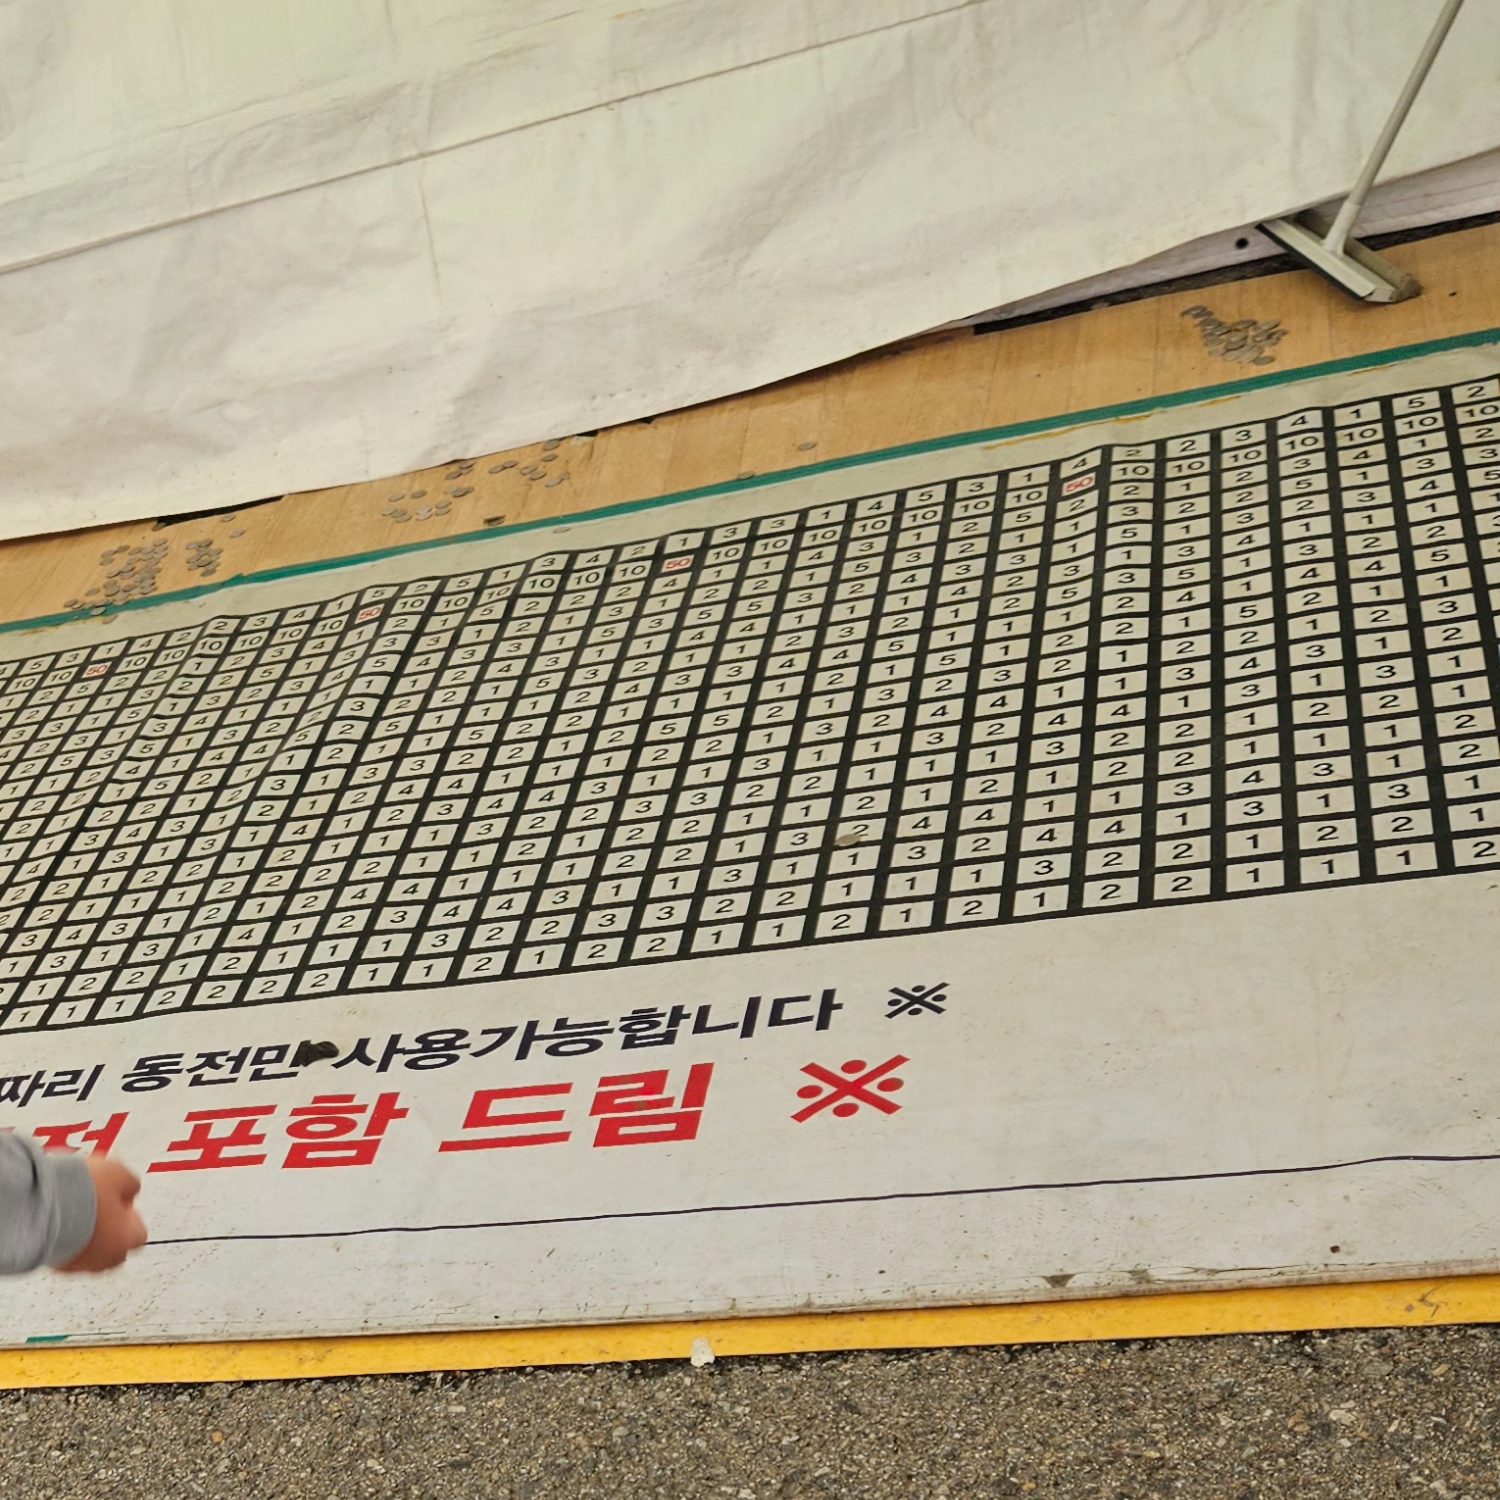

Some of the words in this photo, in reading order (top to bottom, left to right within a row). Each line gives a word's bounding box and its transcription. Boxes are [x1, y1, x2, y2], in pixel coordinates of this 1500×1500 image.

[488, 587, 511, 599] 10
[531, 578, 555, 589] 10
[576, 572, 600, 585] 10
[620, 565, 646, 577] 10
[666, 558, 691, 569] 50
[714, 548, 740, 560] 10
[761, 539, 788, 551] 10
[810, 530, 837, 542] 10
[859, 520, 887, 532] 10
[909, 510, 938, 522] 10
[961, 501, 990, 512] 10
[1013, 491, 1043, 503] 10
[1066, 477, 1093, 492] 50
[1120, 465, 1149, 476] 10
[1173, 461, 1205, 473] 10
[1230, 450, 1262, 462] 10
[1286, 436, 1319, 450] 10
[1343, 428, 1377, 441] 10
[1404, 416, 1438, 429] 10
[1464, 405, 1499, 417] 10
[503, 570, 510, 579] 1
[541, 558, 556, 567] 3
[586, 554, 600, 563] 4
[631, 546, 646, 556] 2
[680, 537, 688, 547] 1
[723, 527, 738, 538] 3
[770, 519, 785, 528] 3
[822, 510, 830, 519] 1
[868, 501, 882, 510] 4
[918, 490, 933, 502] 5
[969, 482, 984, 492] 3
[1024, 472, 1032, 482] 1
[1072, 458, 1087, 469] 4
[1180, 440, 1196, 452] 2
[1236, 429, 1252, 442] 3
[1291, 415, 1308, 426] 4
[1350, 409, 1361, 419] 1
[1408, 397, 1425, 408] 5
[1468, 386, 1485, 398] 2
[888, 640, 904, 652] 5
[947, 631, 956, 642] 1
[1003, 621, 1013, 632] 1
[1061, 611, 1071, 622] 1
[1117, 596, 1134, 609] 2
[1176, 591, 1195, 602] 4
[1241, 581, 1251, 591] 1
[1300, 567, 1320, 579] 4
[1364, 560, 1385, 571] 4
[1431, 549, 1450, 562] 5
[5, 847, 13, 857] 1
[46, 840, 54, 850] 1
[84, 834, 99, 846] 3
[126, 827, 141, 838] 4
[170, 821, 186, 832] 3
[219, 814, 227, 825] 1
[257, 805, 275, 816] 2
[309, 799, 317, 810] 1
[350, 792, 368, 804] 2
[398, 784, 414, 795] 4
[447, 778, 463, 789] 4
[502, 773, 511, 784] 1
[552, 765, 561, 776] 1
[604, 756, 612, 767] 1
[651, 748, 669, 761] 2
[705, 739, 722, 753] 2
[764, 732, 773, 744] 1
[816, 722, 833, 735] 3
[872, 714, 890, 727] 2
[930, 705, 949, 717] 4
[990, 695, 1008, 707] 4
[1054, 686, 1064, 698] 1
[1115, 677, 1126, 690] 1
[1176, 667, 1195, 681] 3
[1239, 657, 1260, 669] 4
[1306, 645, 1325, 658] 3
[1375, 637, 1387, 649] 1
[1442, 627, 1463, 641] 2
[20, 1011, 30, 1022] 1
[67, 1005, 77, 1018] 1
[115, 1000, 125, 1012] 1
[157, 991, 176, 1005] 2
[207, 985, 226, 999] 2
[259, 980, 277, 994] 2
[310, 973, 329, 988] 2
[368, 968, 379, 981] 1
[423, 964, 433, 977] 1
[473, 957, 492, 972] 2
[535, 950, 545, 964] 1
[587, 944, 607, 959] 2
[647, 937, 666, 952] 2
[711, 930, 722, 944] 1
[772, 923, 784, 937] 1
[831, 914, 851, 930] 2
[900, 908, 912, 923] 1
[962, 900, 983, 916] 2
[1034, 892, 1045, 907] 1
[1100, 884, 1121, 900] 2
[1171, 876, 1192, 892] 2
[1247, 868, 1259, 883] 1
[1321, 859, 1334, 874] 1
[1397, 850, 1410, 865] 1
[1473, 841, 1496, 858] 2
[21, 934, 38, 947] 3
[66, 929, 82, 940] 4
[112, 923, 128, 935] 3
[163, 916, 172, 928] 1
[203, 907, 221, 920] 2
[257, 902, 266, 913] 1
[301, 895, 319, 908] 2
[351, 888, 368, 899] 4
[402, 883, 419, 895] 4
[459, 877, 469, 890] 1
[512, 870, 522, 883] 1
[566, 863, 576, 875] 1
[616, 855, 635, 868] 2
[673, 848, 692, 861] 2
[735, 840, 745, 853] 1
[790, 832, 809, 846] 3
[912, 816, 931, 829] 4
[975, 809, 994, 821] 4
[1043, 800, 1054, 812] 1
[1109, 791, 1120, 804] 1
[1174, 782, 1194, 796] 3
[1242, 770, 1264, 784] 4
[1313, 763, 1334, 776] 3
[1387, 754, 1400, 768] 1
[1459, 744, 1481, 758] 2
[121, 1040, 311, 1094] 동전만
[330, 989, 844, 1074] 사용가능합니다
[146, 1093, 409, 1173] 포함
[438, 1062, 715, 1153] 드림
